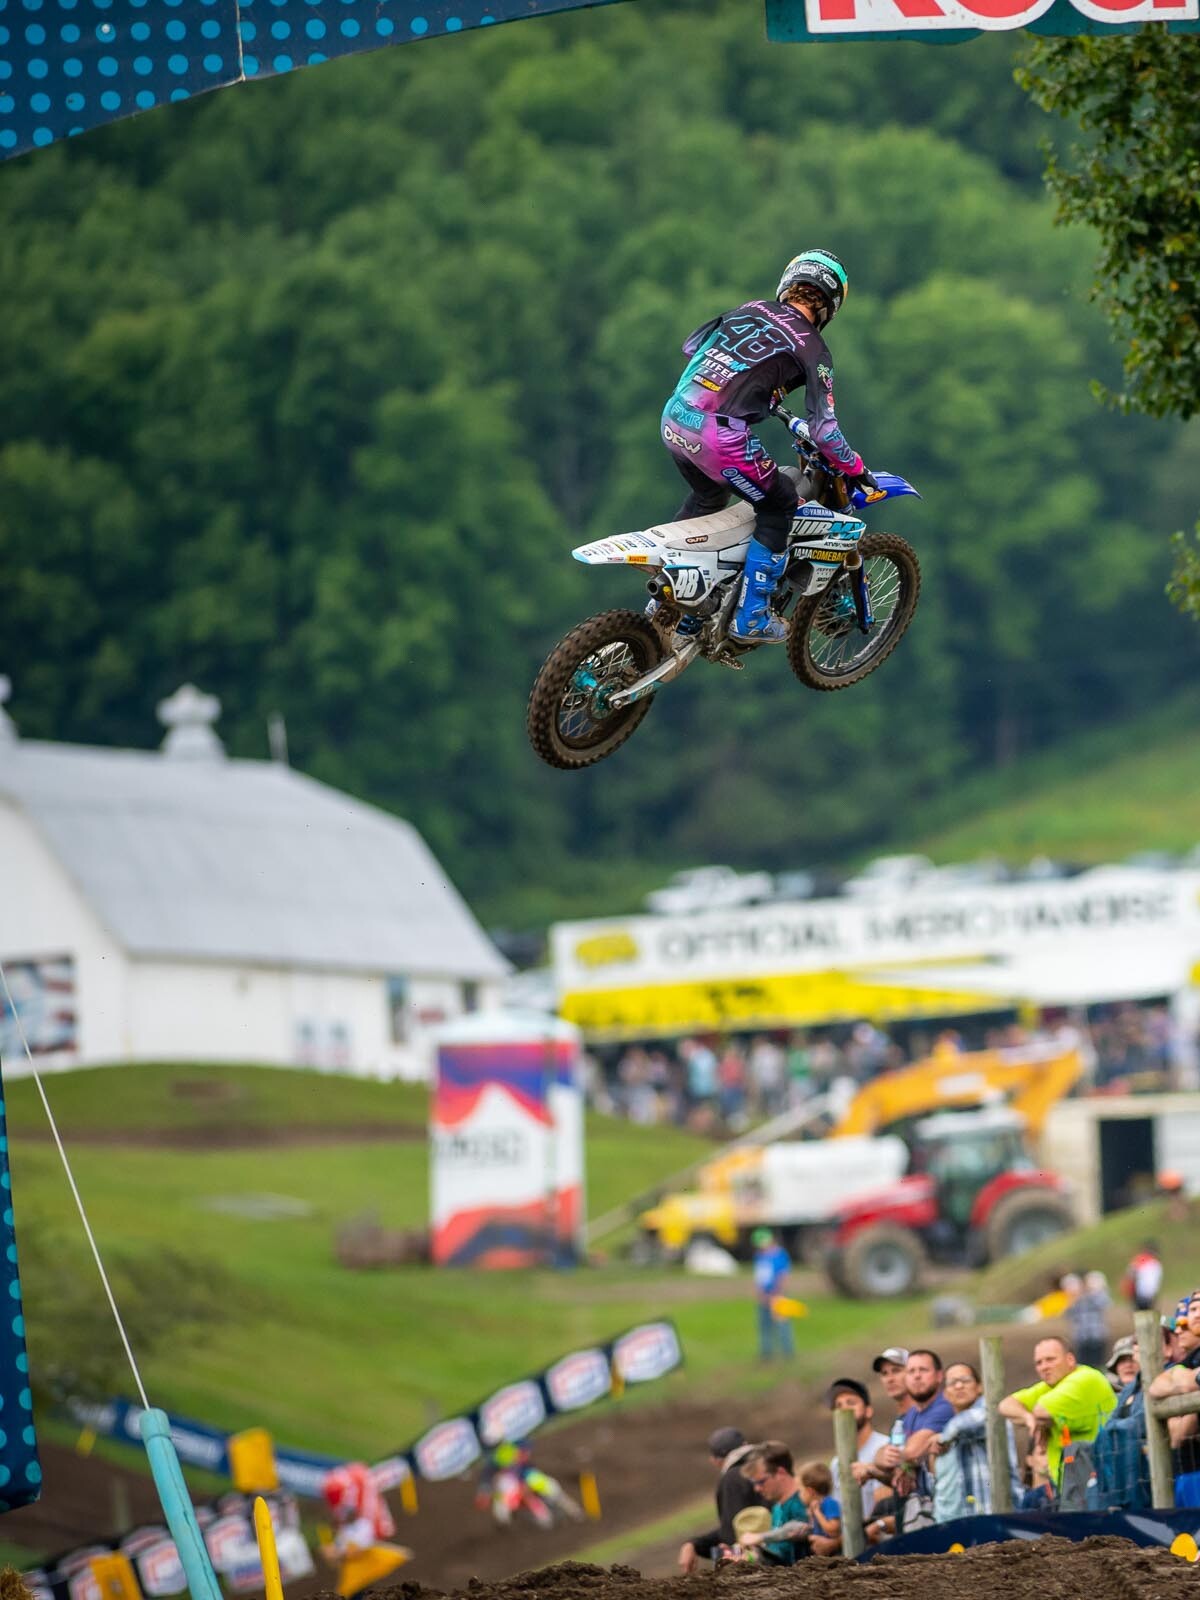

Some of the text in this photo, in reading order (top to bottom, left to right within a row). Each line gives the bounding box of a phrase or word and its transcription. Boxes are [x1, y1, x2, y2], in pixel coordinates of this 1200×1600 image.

[718, 315, 796, 362] 48
[671, 401, 704, 430] FXR
[730, 474, 766, 502] YAMAHA
[809, 508, 833, 516] YAMAHA
[675, 569, 700, 599] 48
